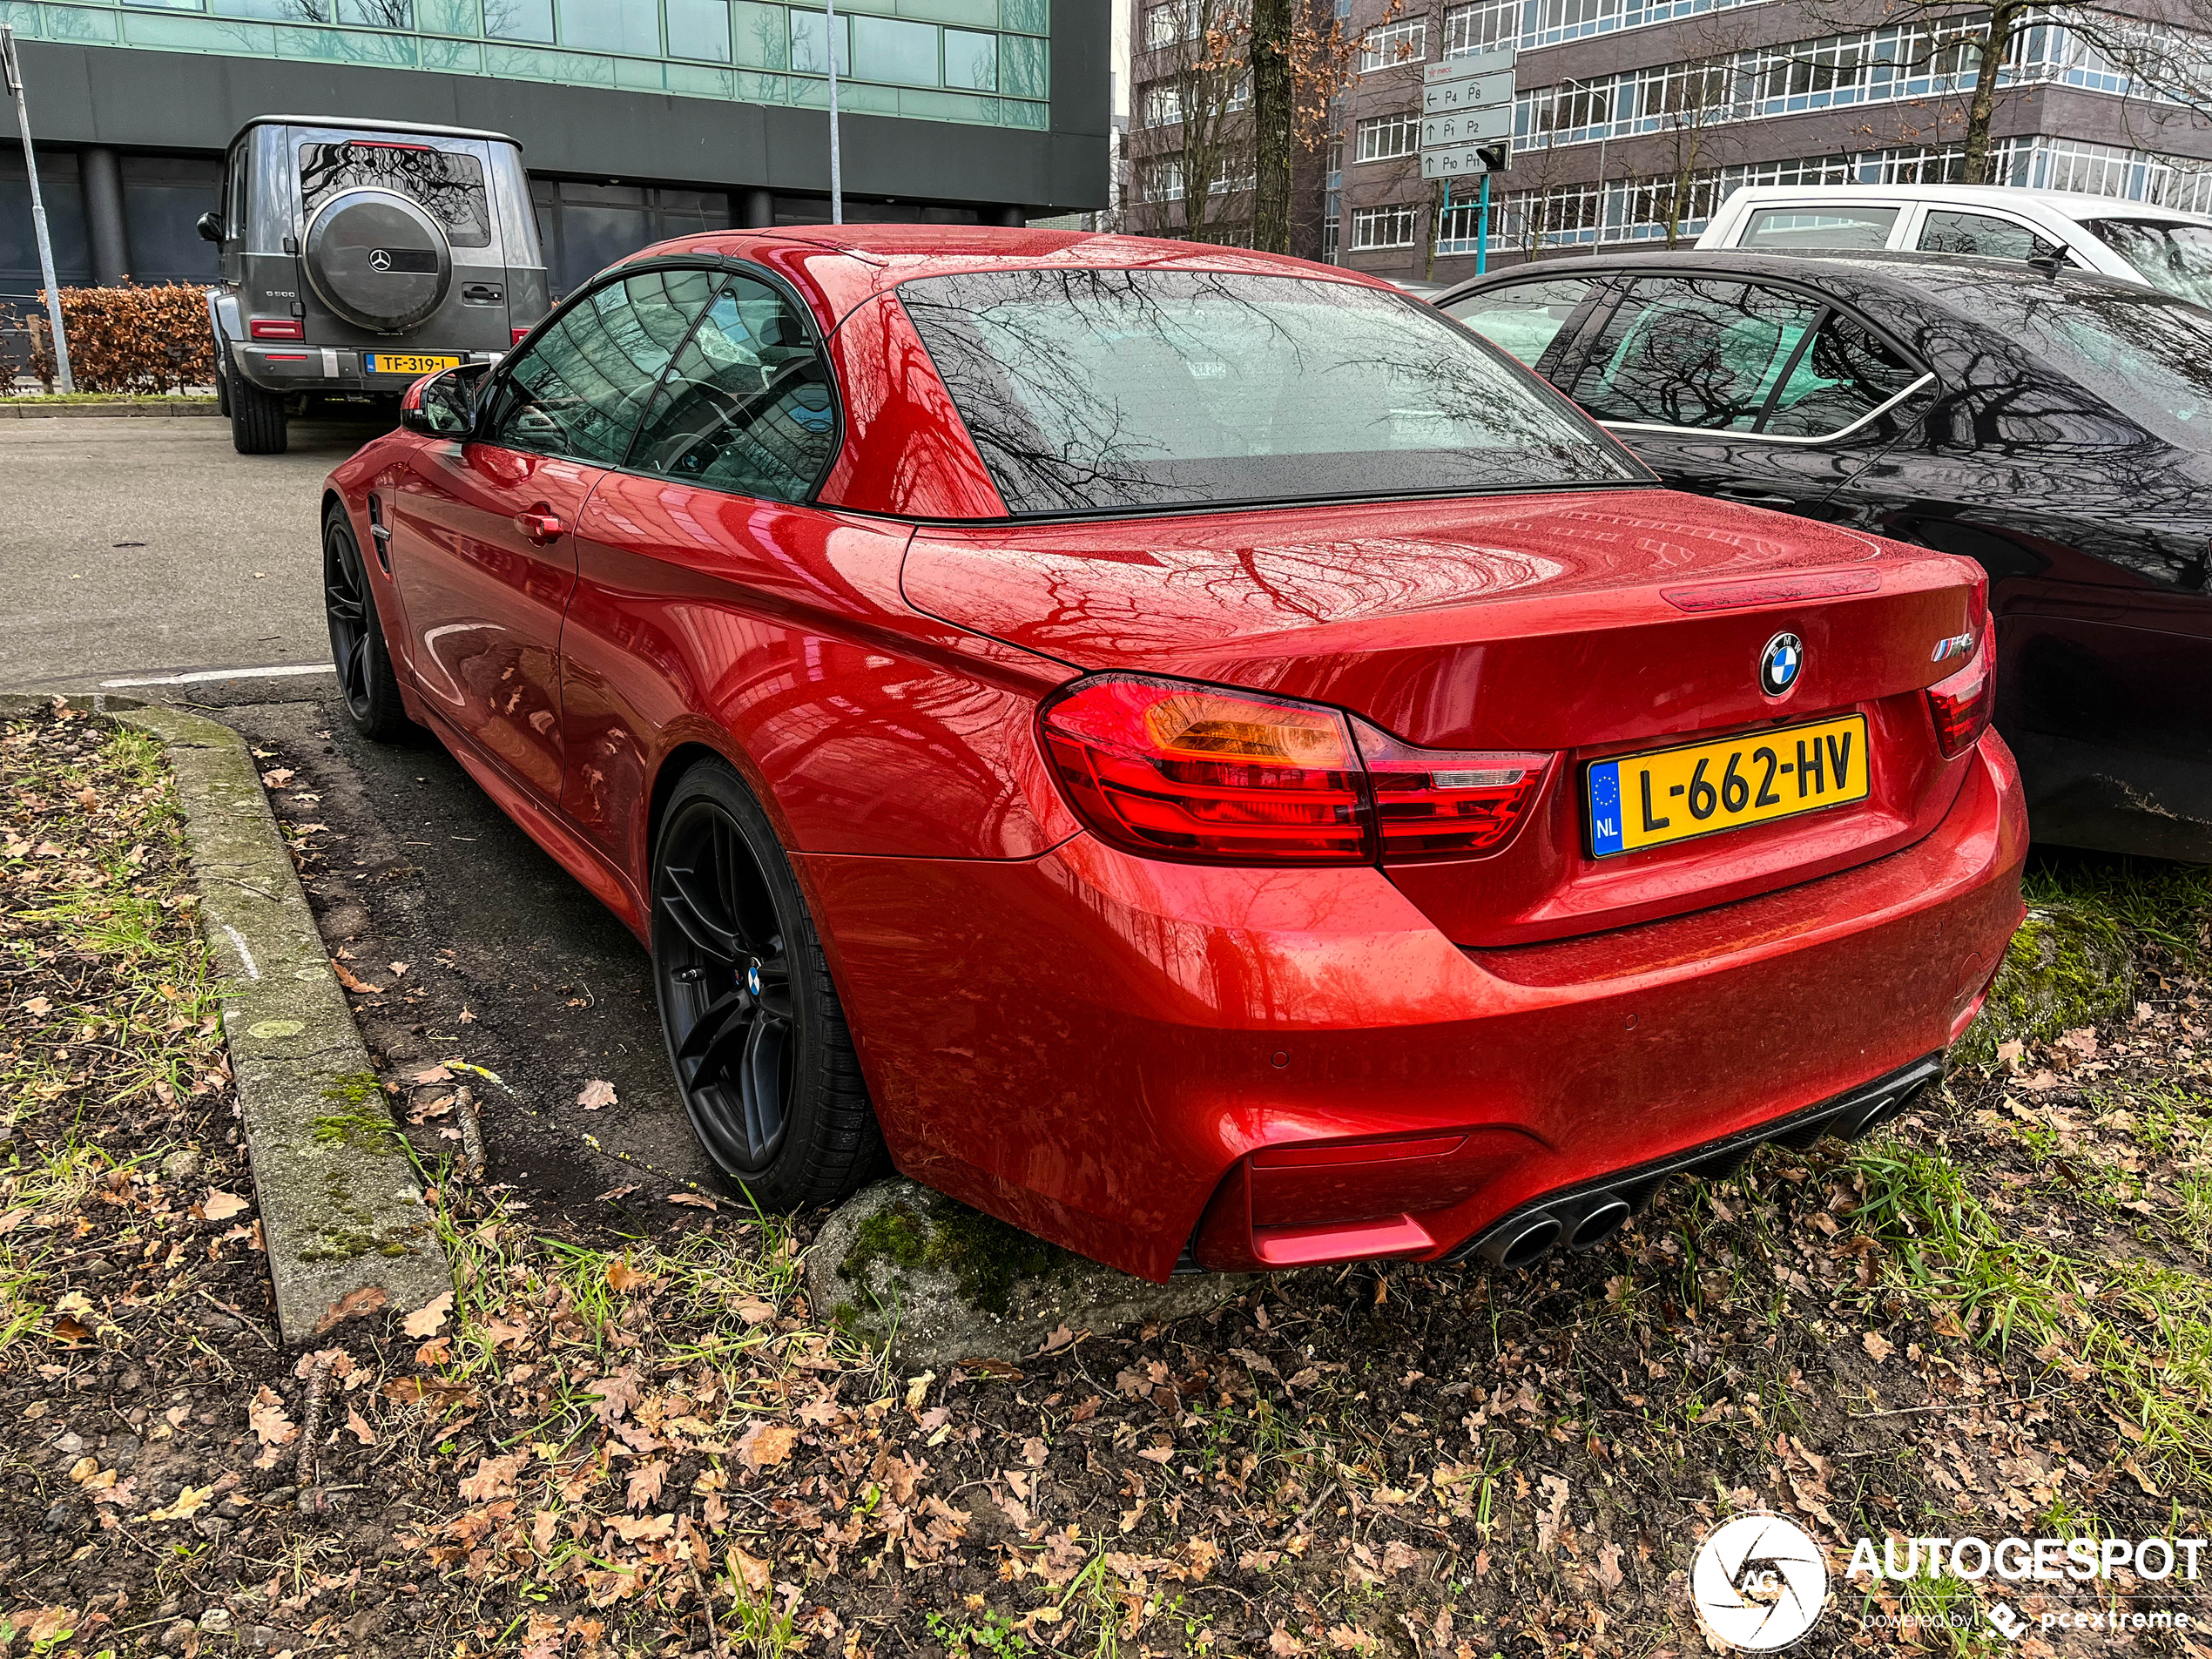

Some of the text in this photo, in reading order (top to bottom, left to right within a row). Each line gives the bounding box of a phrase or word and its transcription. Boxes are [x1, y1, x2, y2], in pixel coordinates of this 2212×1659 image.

[1445, 87, 1480, 104] P4 P8
[1444, 120, 1479, 137] P1 P2
[1443, 153, 1479, 170] P10 P11
[1770, 635, 1802, 658] BMW
[1640, 731, 1852, 833] L-662-HV
[1596, 817, 1618, 839] NL
